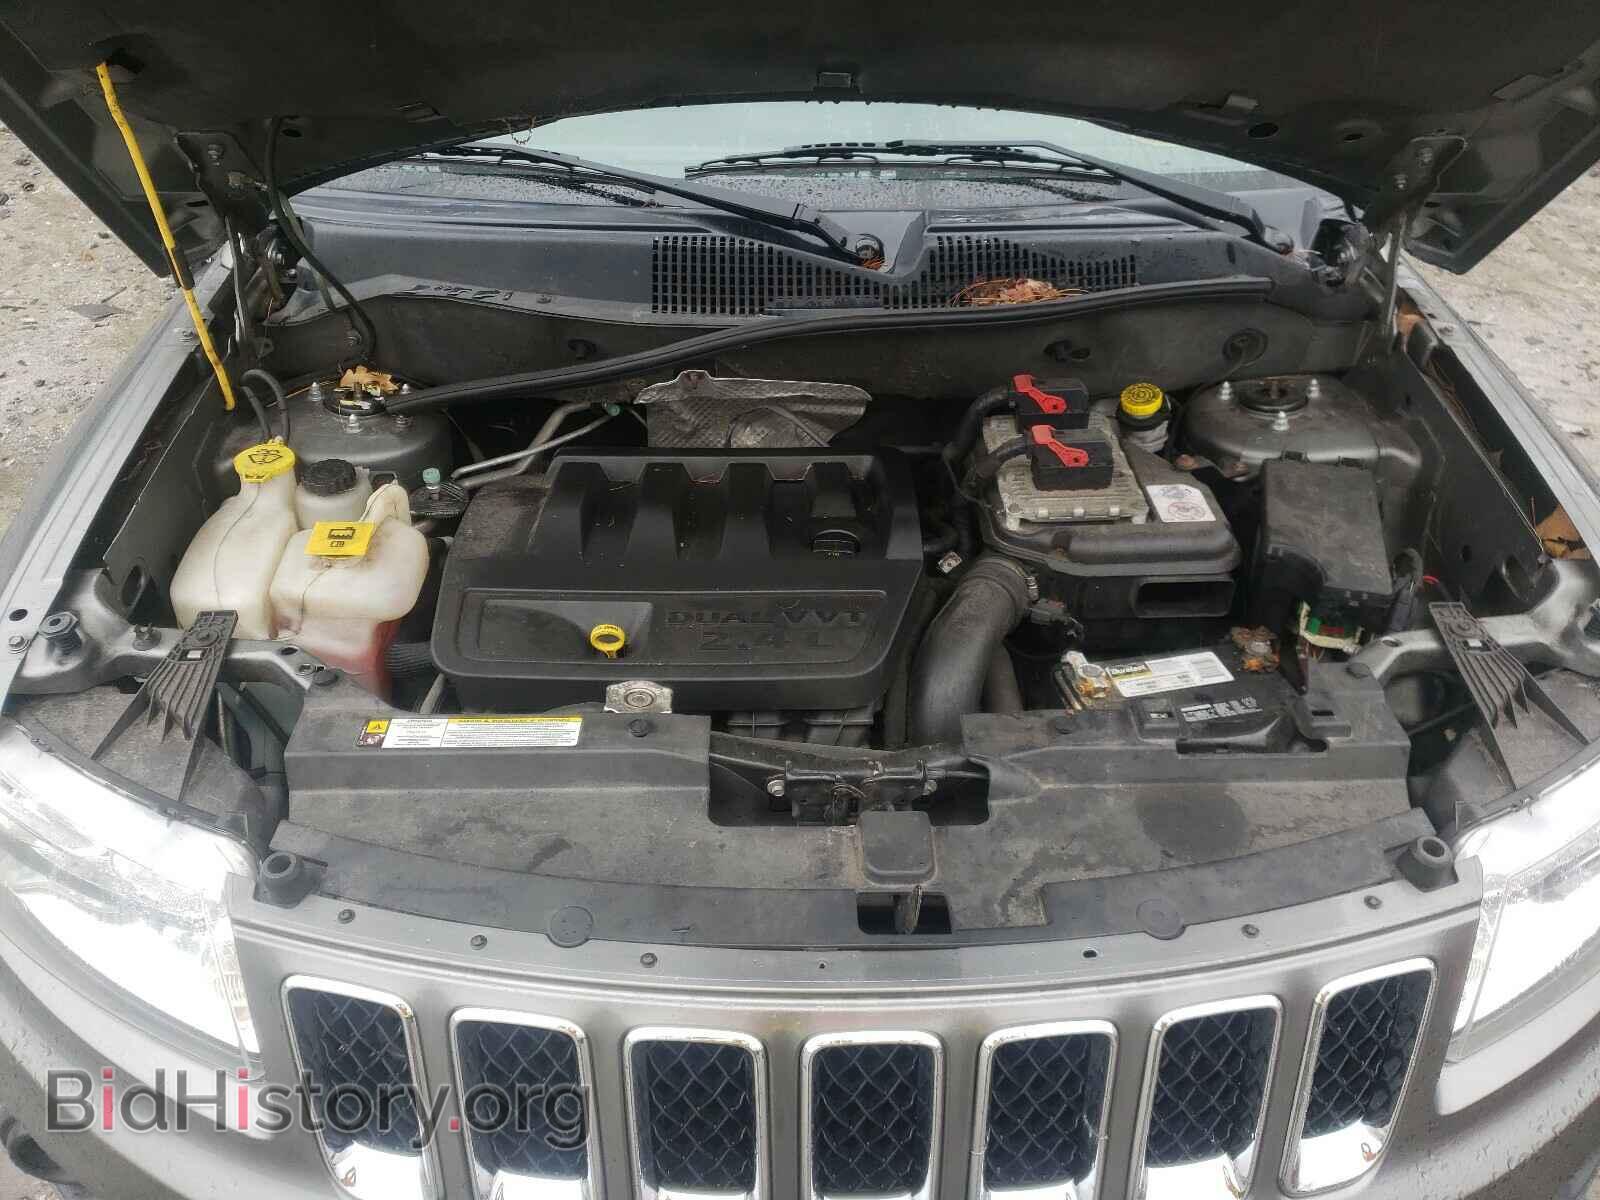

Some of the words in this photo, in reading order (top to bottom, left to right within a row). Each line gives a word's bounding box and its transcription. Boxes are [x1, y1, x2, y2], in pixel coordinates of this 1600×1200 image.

[665, 608, 775, 626] DUAL
[781, 608, 865, 625] VVT
[697, 629, 835, 652] 2.4L
